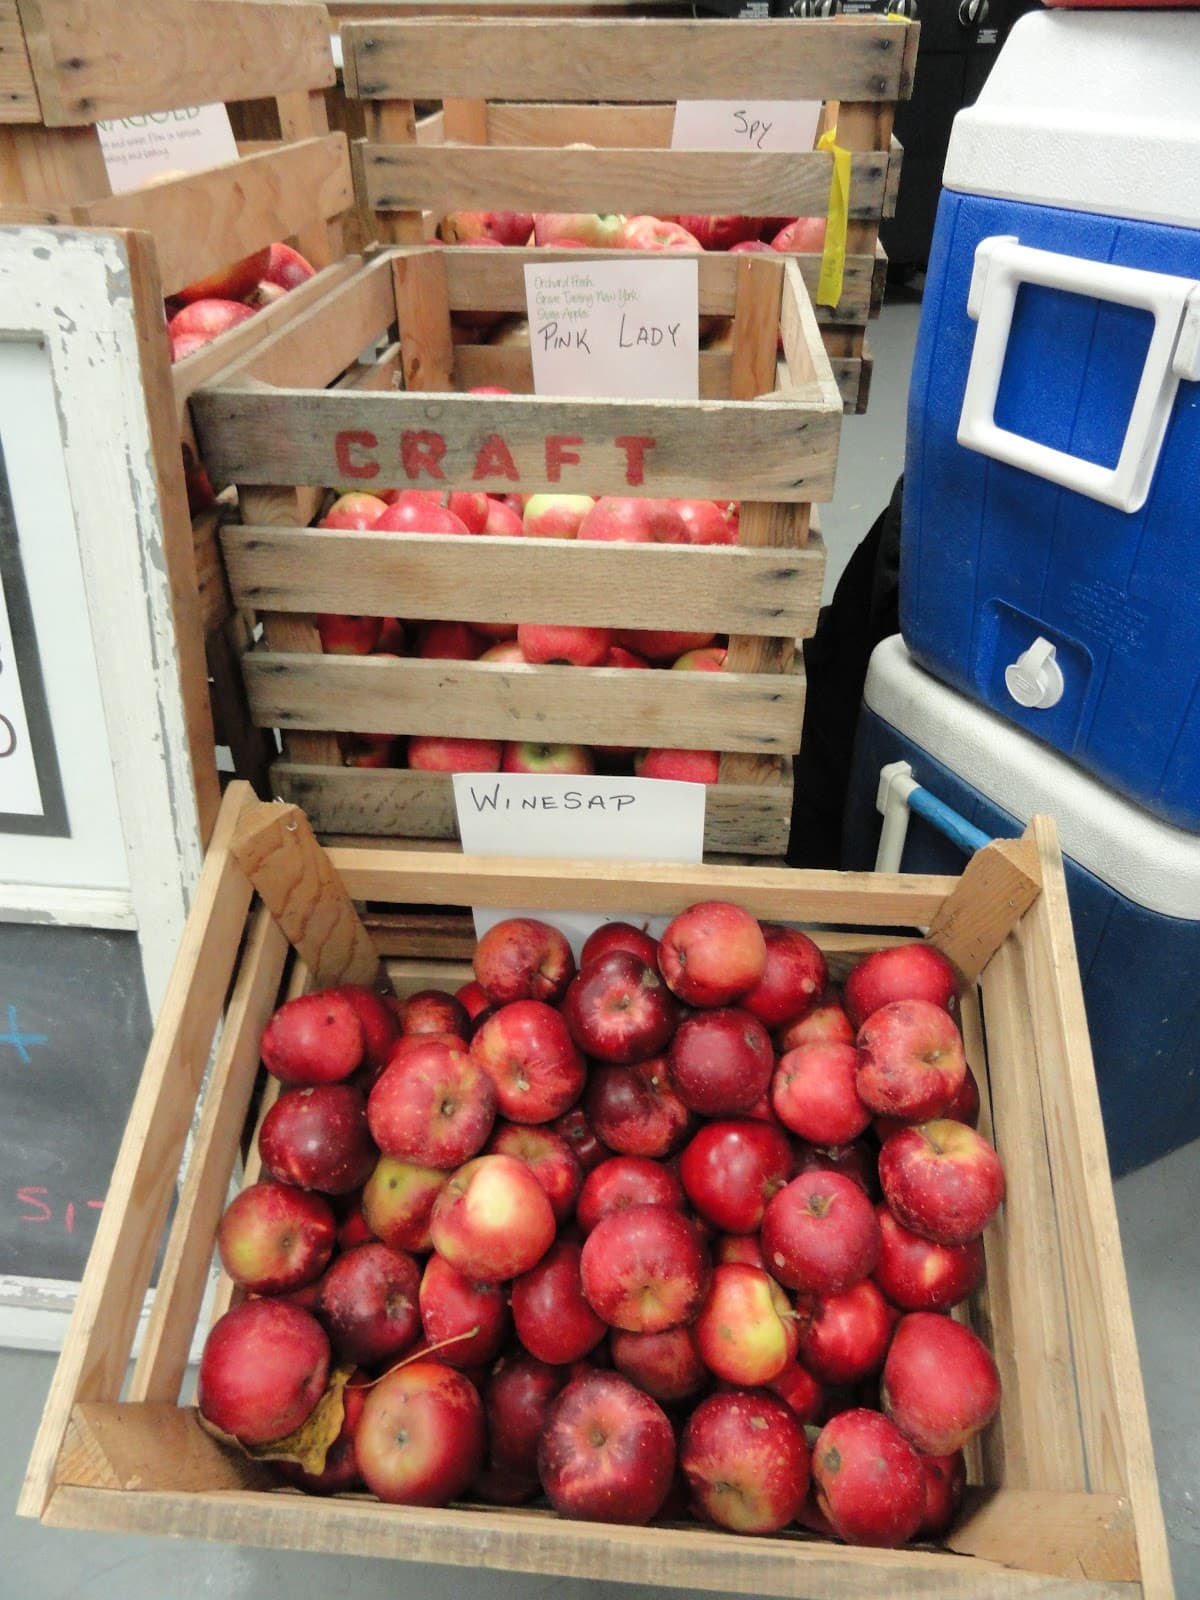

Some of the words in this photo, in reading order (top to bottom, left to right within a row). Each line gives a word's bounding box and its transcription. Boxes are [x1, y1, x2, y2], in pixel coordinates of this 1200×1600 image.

[732, 109, 773, 149] Spy
[618, 313, 681, 349] LADY
[334, 429, 657, 487] CRAFT
